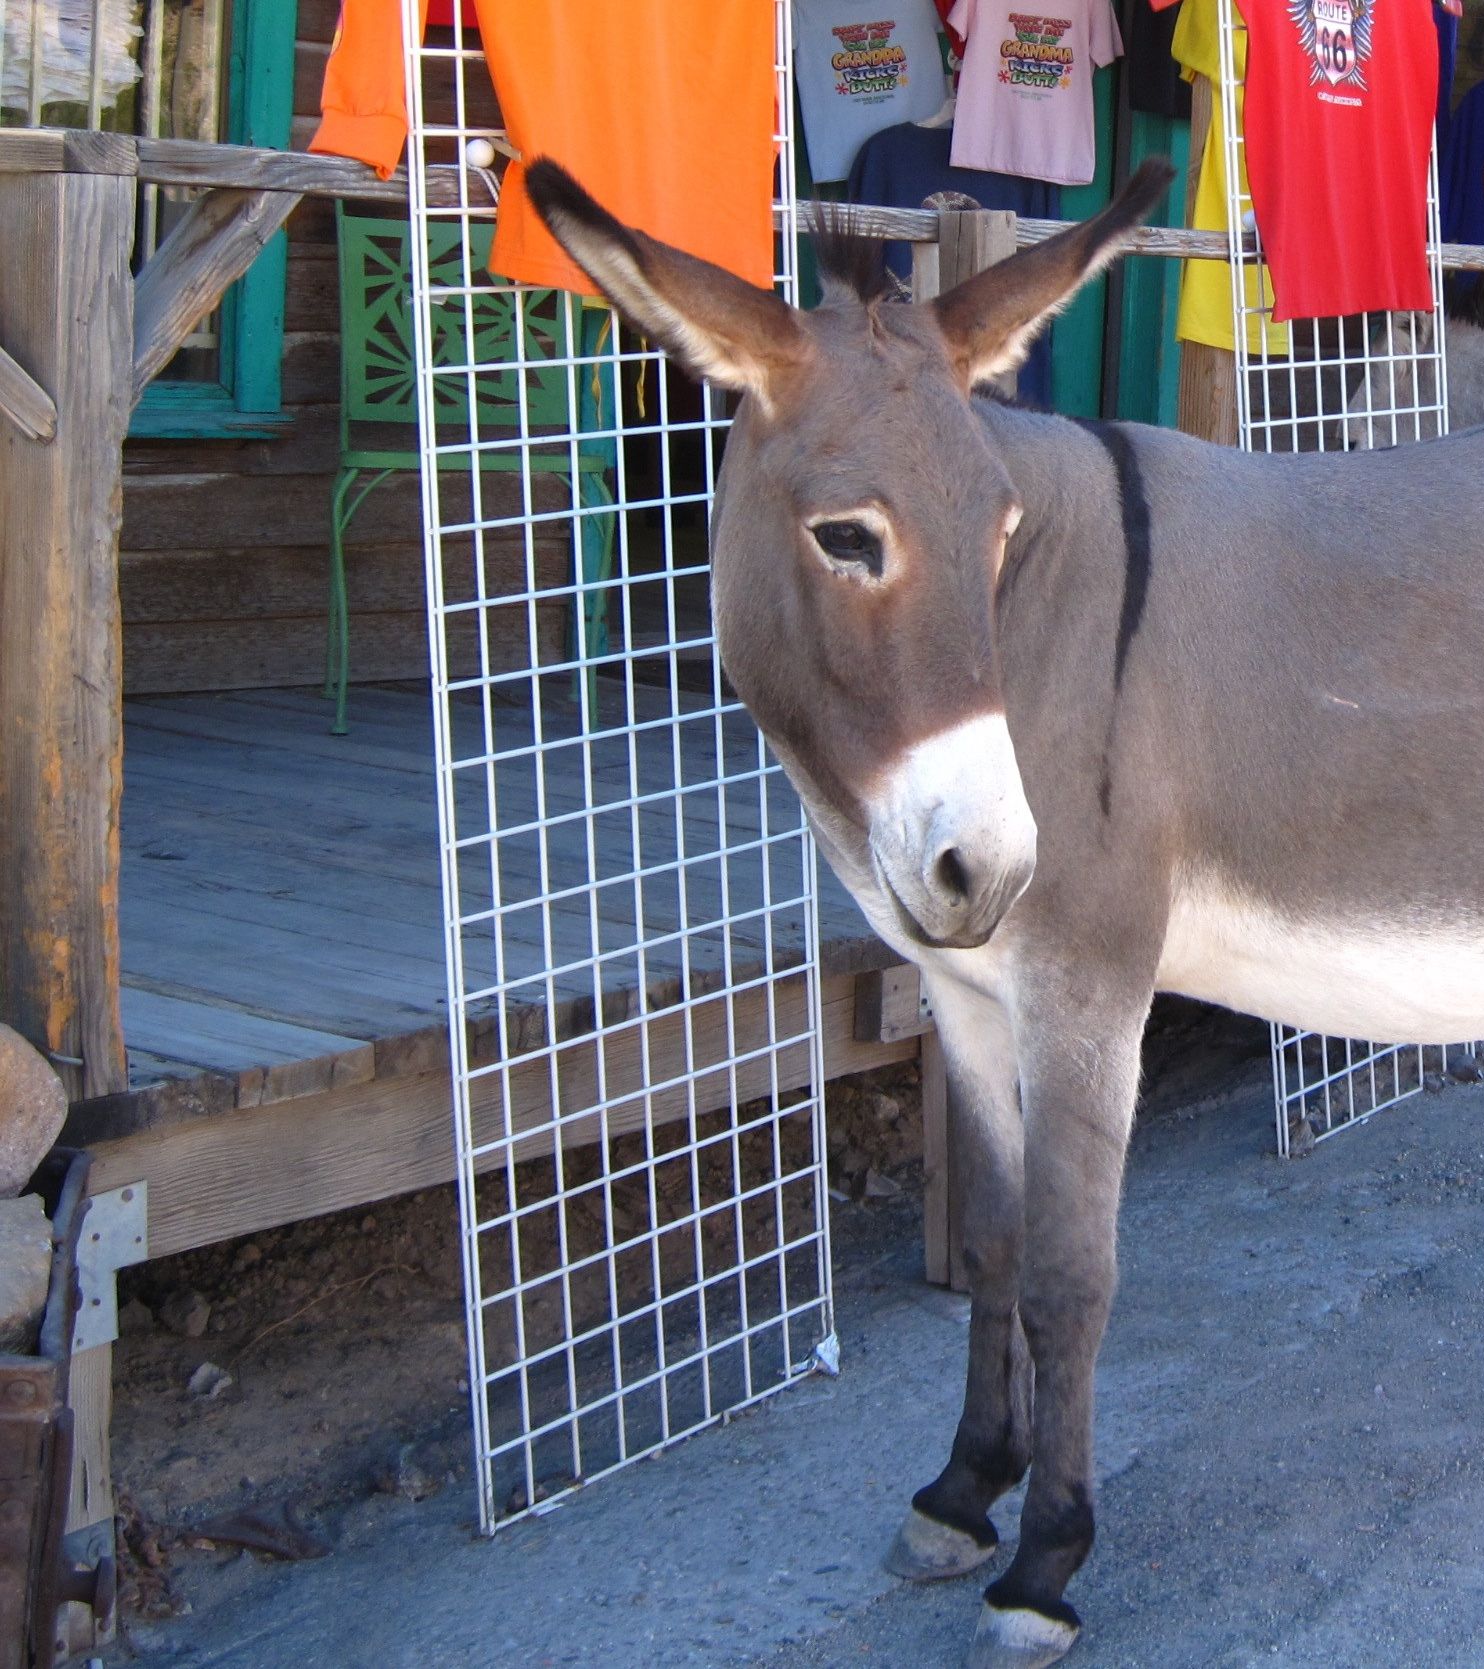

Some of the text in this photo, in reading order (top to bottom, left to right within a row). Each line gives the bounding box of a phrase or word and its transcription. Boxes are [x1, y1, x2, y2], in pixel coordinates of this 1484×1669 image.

[1317, 1, 1347, 21] ROUTE
[832, 46, 906, 71] GRANDPA
[1001, 40, 1073, 64] GRANDMA
[1322, 26, 1347, 73] 66
[843, 65, 899, 83] KICKS
[1008, 60, 1064, 77] KICKS
